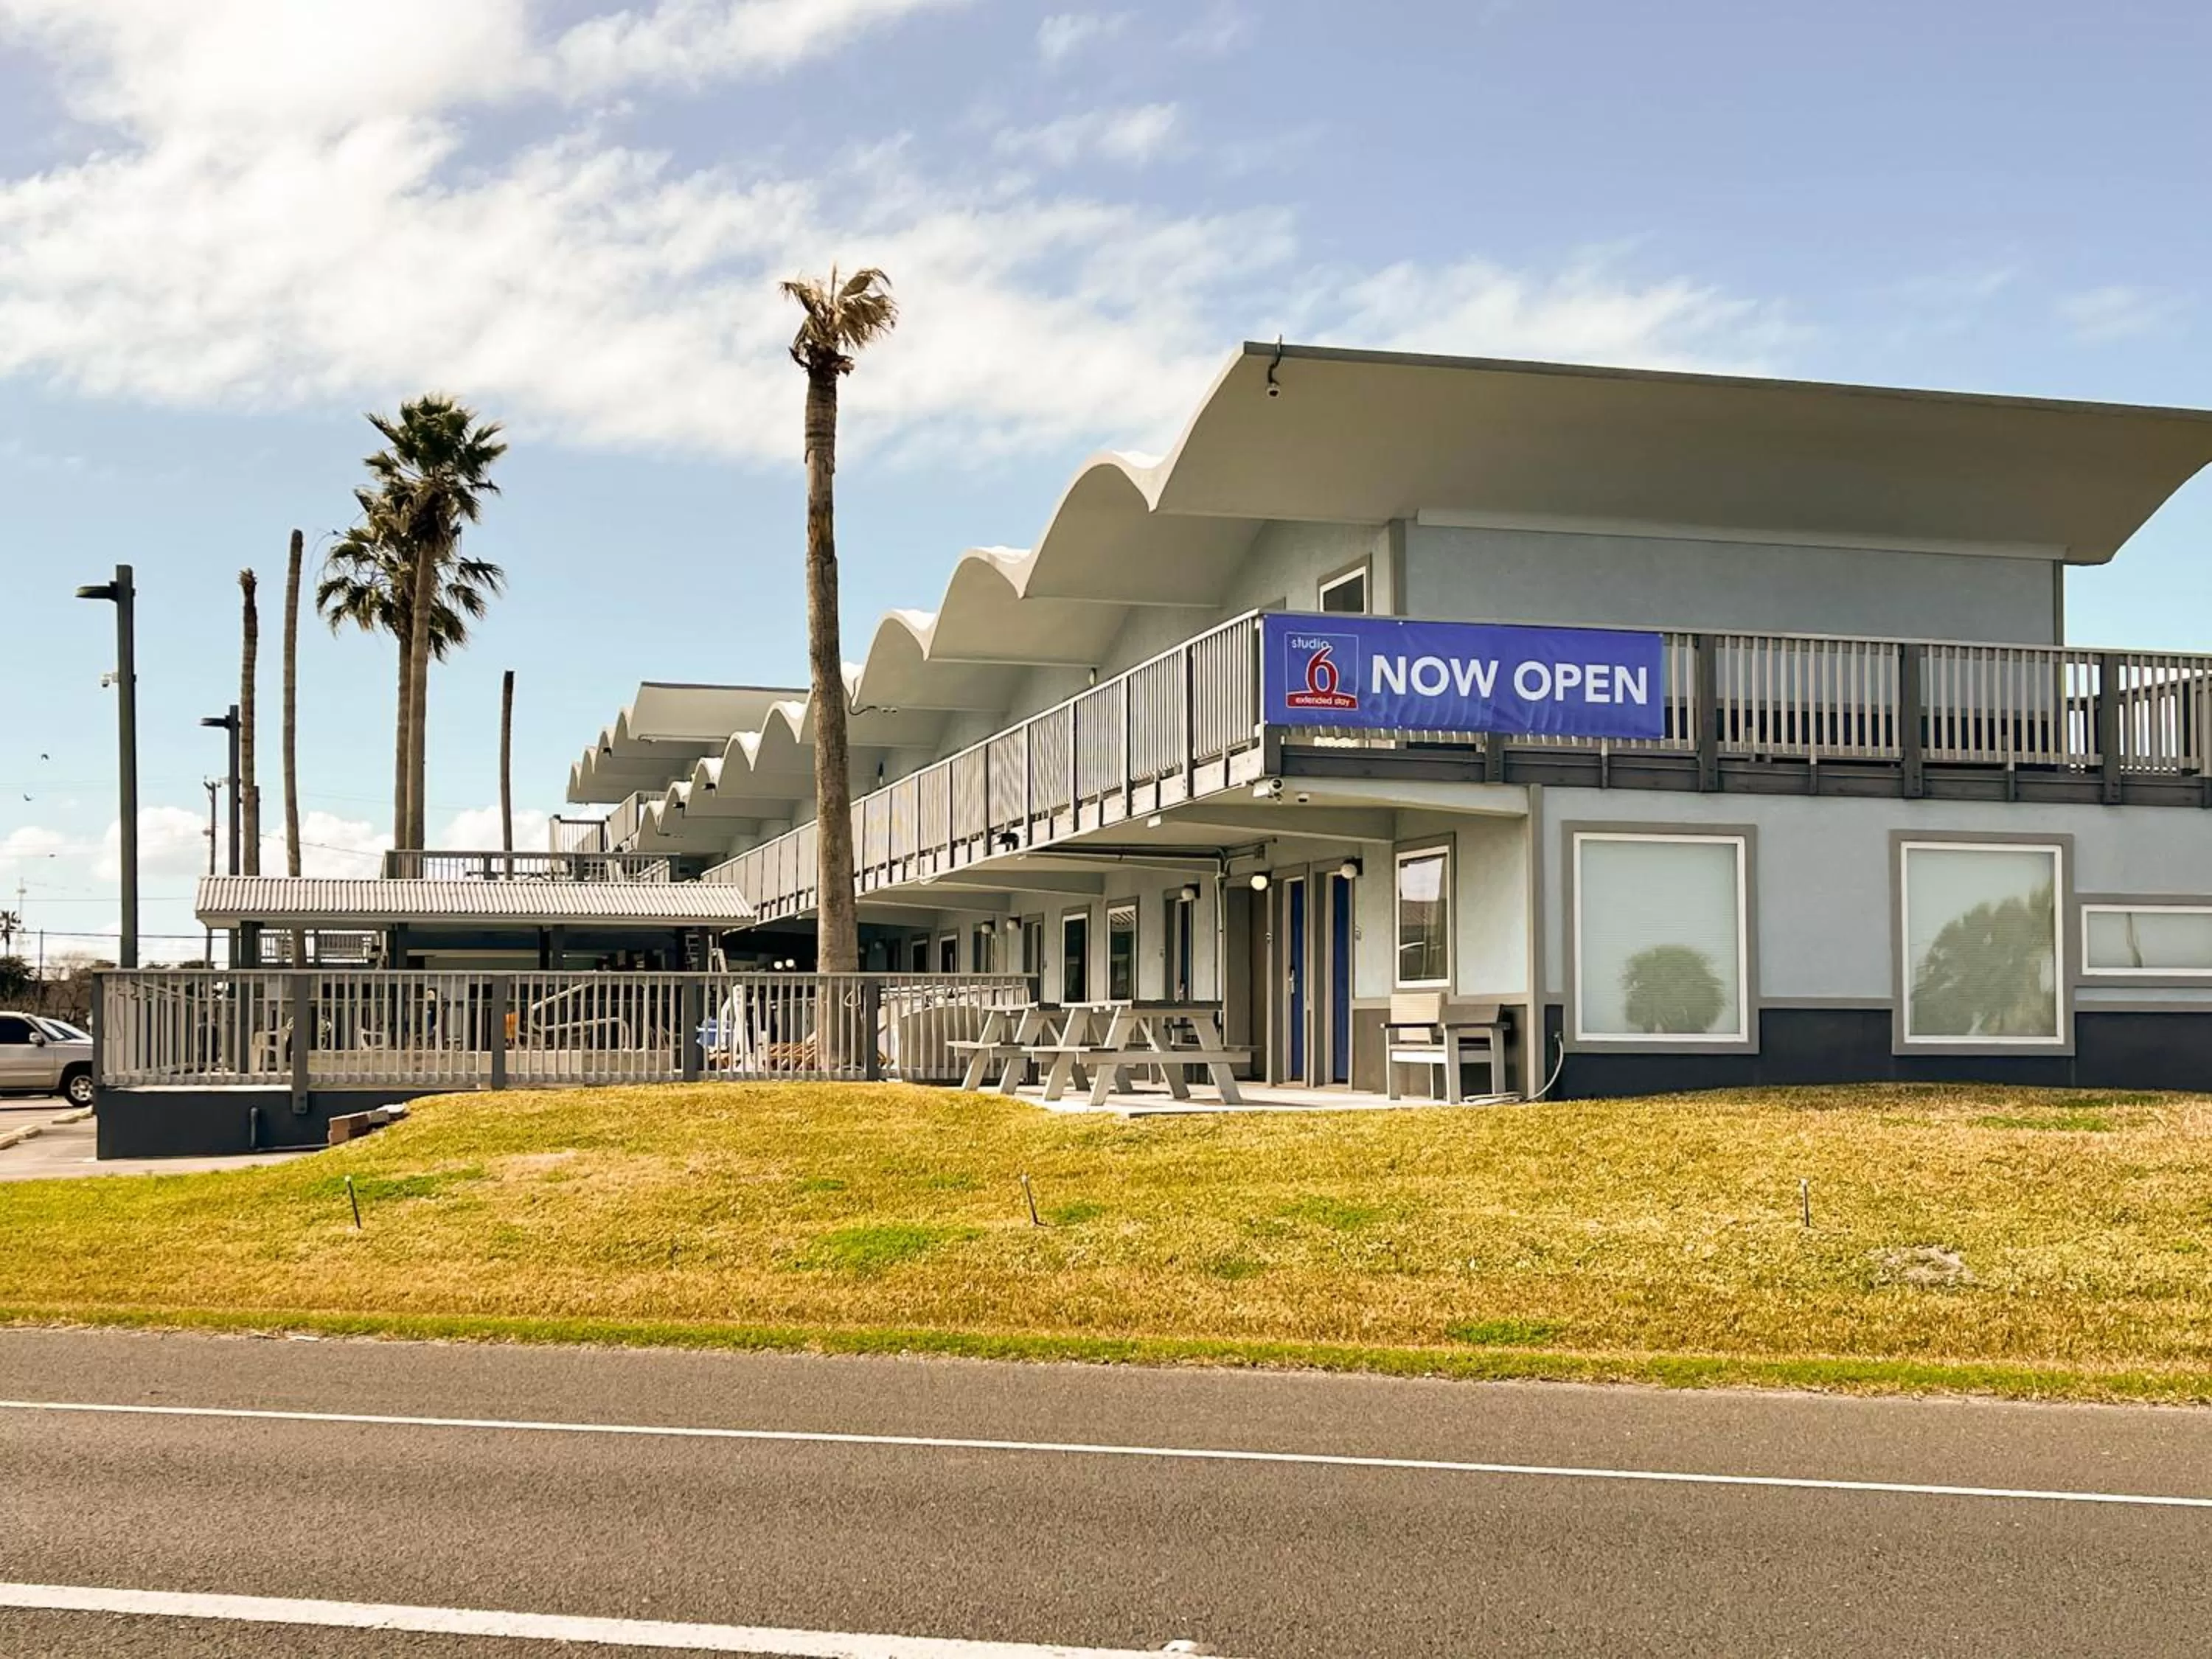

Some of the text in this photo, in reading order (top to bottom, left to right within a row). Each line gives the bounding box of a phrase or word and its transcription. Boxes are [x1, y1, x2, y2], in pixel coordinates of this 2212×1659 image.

[1291, 637, 1329, 649] studio
[1305, 645, 1338, 694] 6
[1371, 654, 1648, 704] NOW OPEN
[1295, 696, 1350, 706] extended stay
